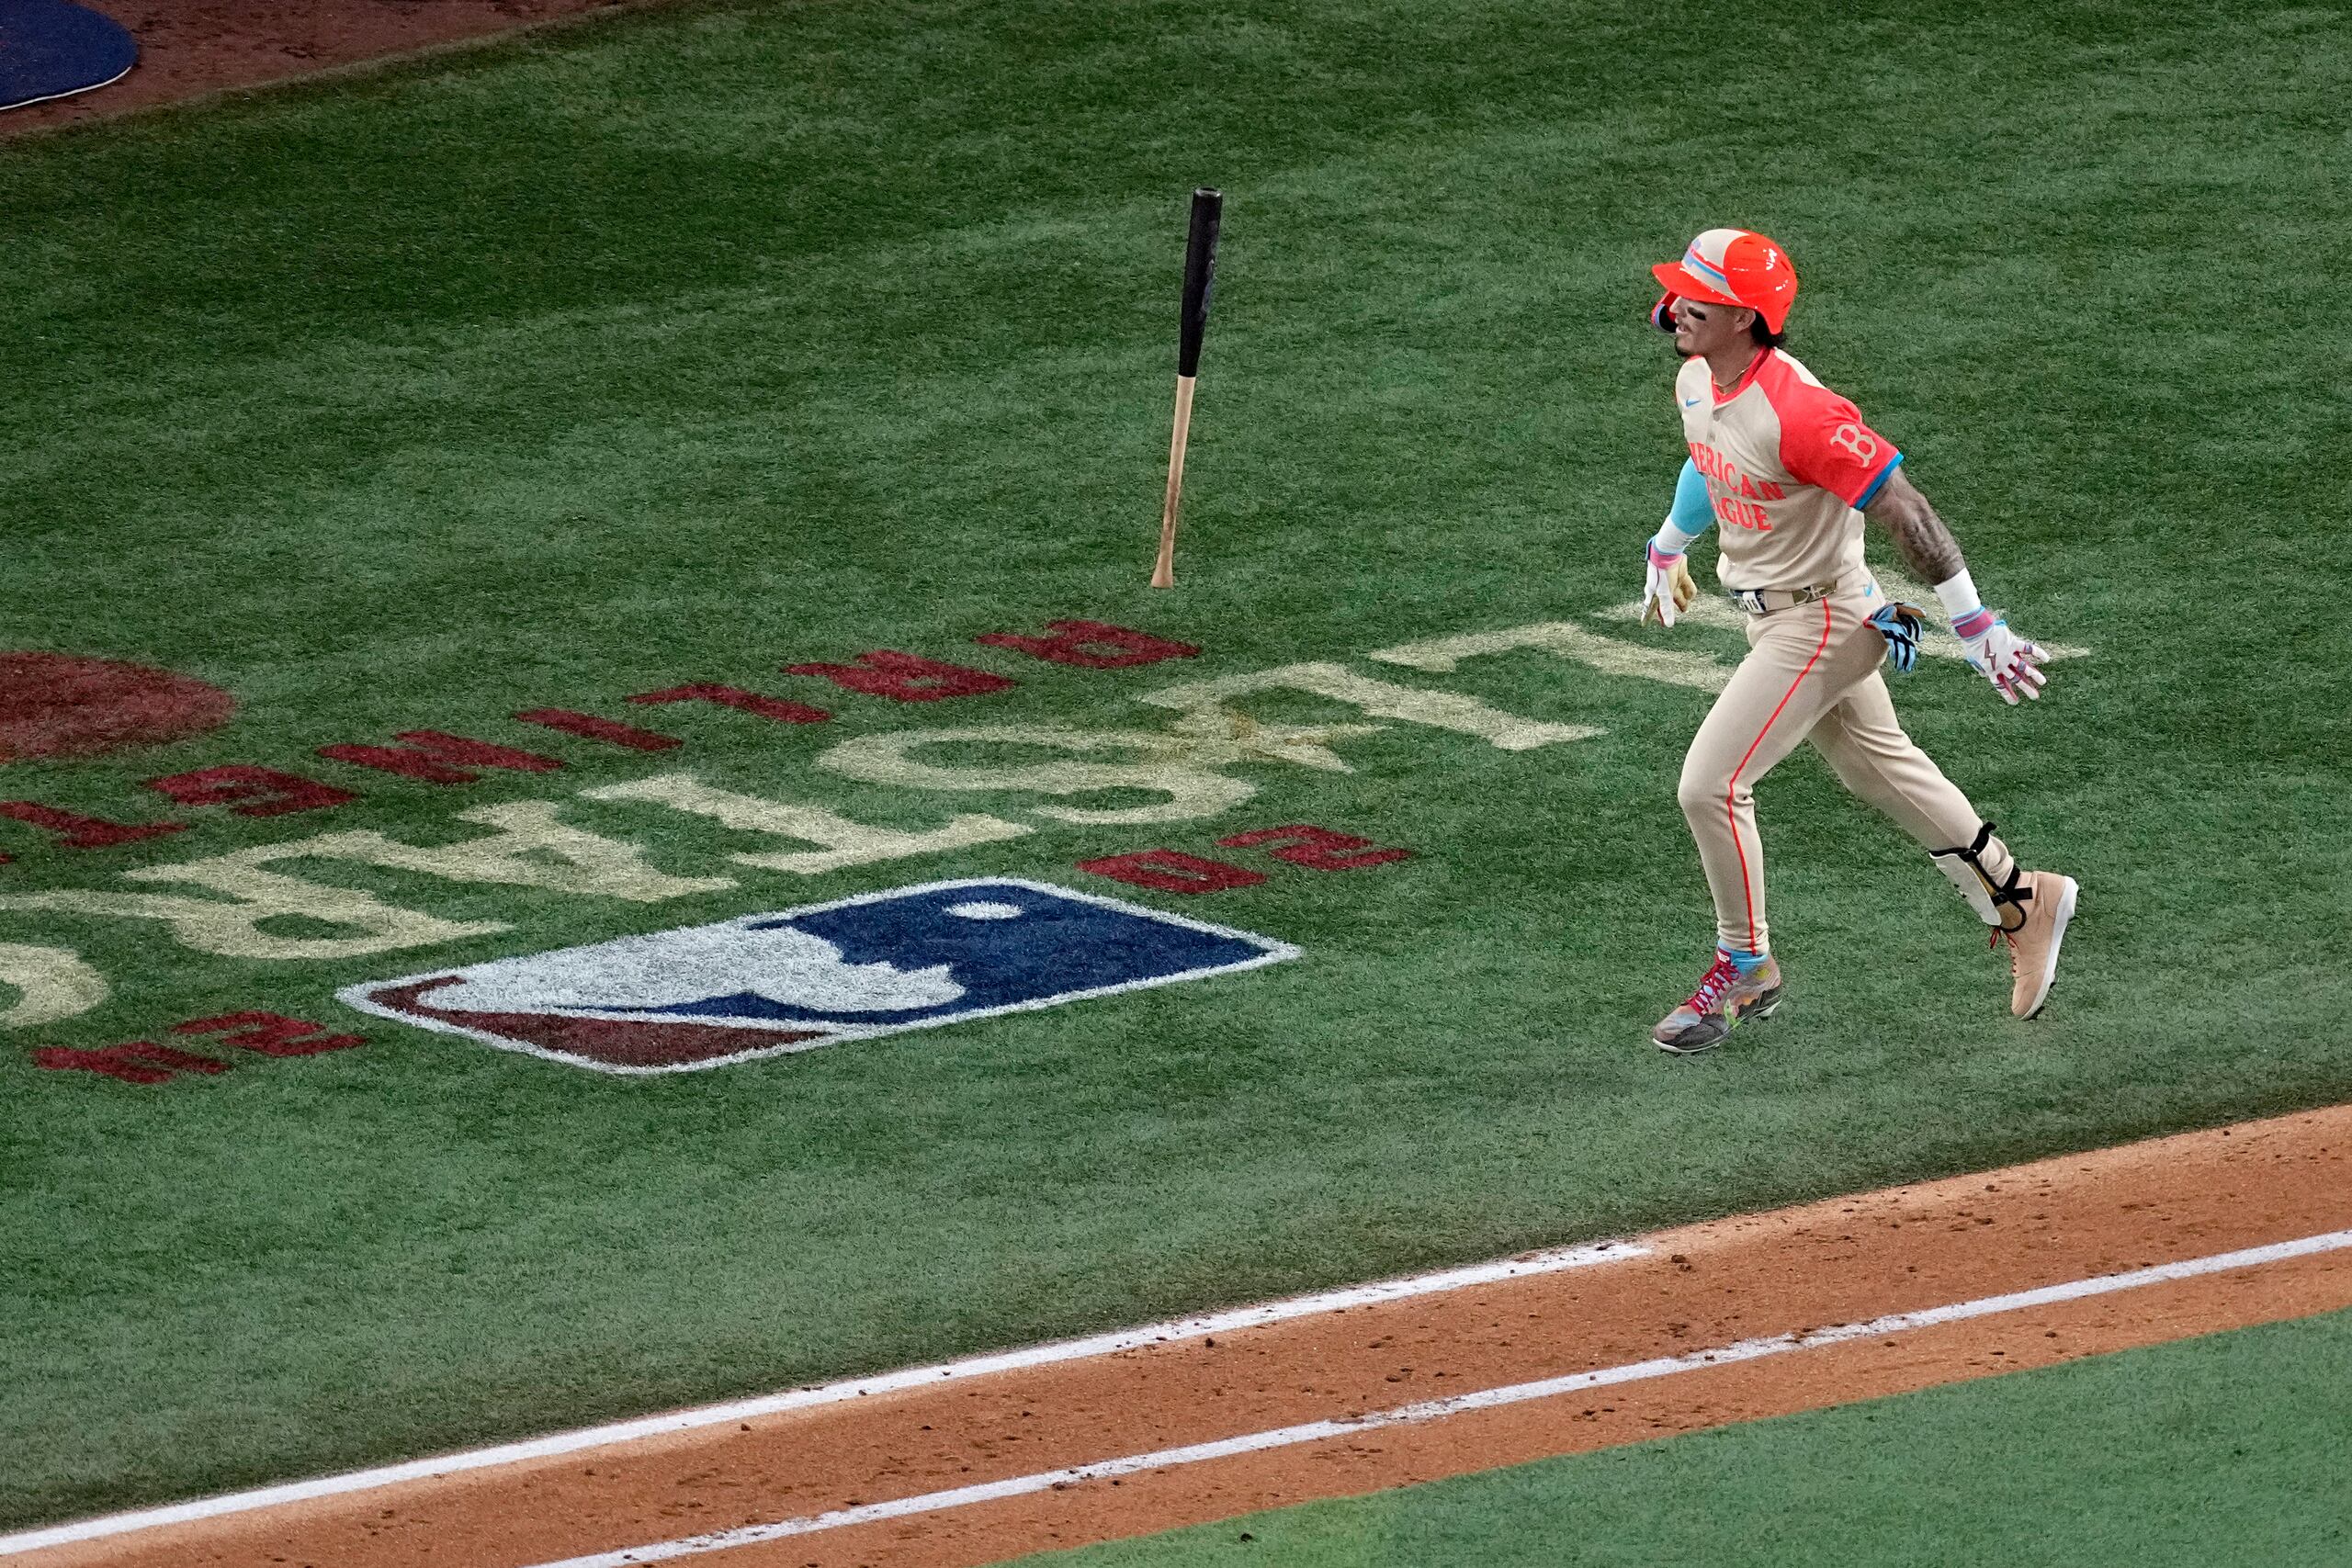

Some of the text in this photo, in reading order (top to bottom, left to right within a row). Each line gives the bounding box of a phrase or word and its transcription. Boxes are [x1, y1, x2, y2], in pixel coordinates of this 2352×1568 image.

[1689, 442, 1787, 502] ERICAN
[1830, 423, 1877, 468] B
[0, 619, 1200, 866] ARLINGT
[1079, 824, 1415, 896] 20
